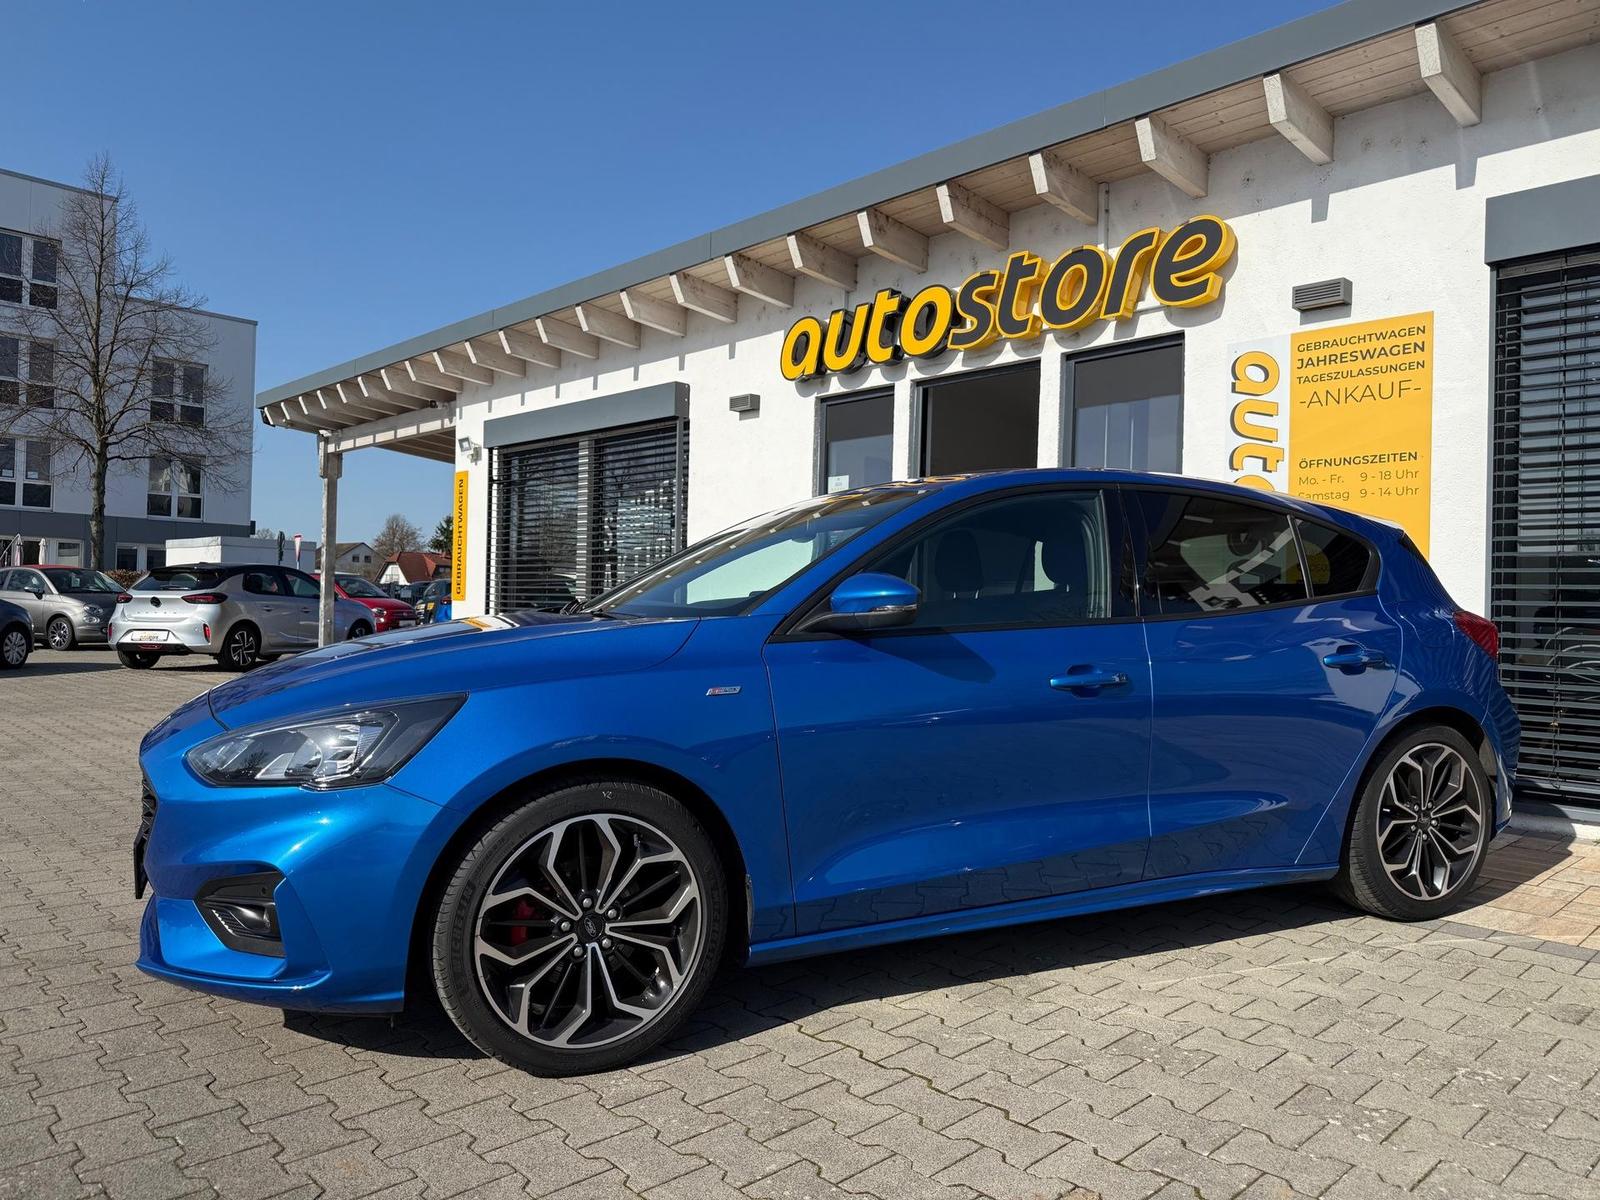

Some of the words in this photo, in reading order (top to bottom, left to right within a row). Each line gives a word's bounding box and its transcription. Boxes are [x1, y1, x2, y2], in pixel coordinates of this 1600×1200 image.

[780, 214, 1237, 383] autostore
[1297, 325, 1426, 353] GEBRAUCHTWAGEN
[1296, 341, 1426, 370] JAHRESWAGEN
[1296, 360, 1425, 385] TAGESZULASSUNGEN
[1298, 451, 1418, 469] ÖFFNUNGSZEITEN
[1298, 475, 1319, 486] Mo.
[1330, 473, 1345, 485] Fr.
[1360, 471, 1368, 482] 9
[1379, 470, 1392, 481] 18
[1395, 469, 1420, 480] Uhr
[1360, 488, 1368, 498] 9
[1379, 487, 1392, 497] 14
[1395, 486, 1420, 496] Uhr
[456, 479, 464, 594] GEBRAUCHTWAGEN
